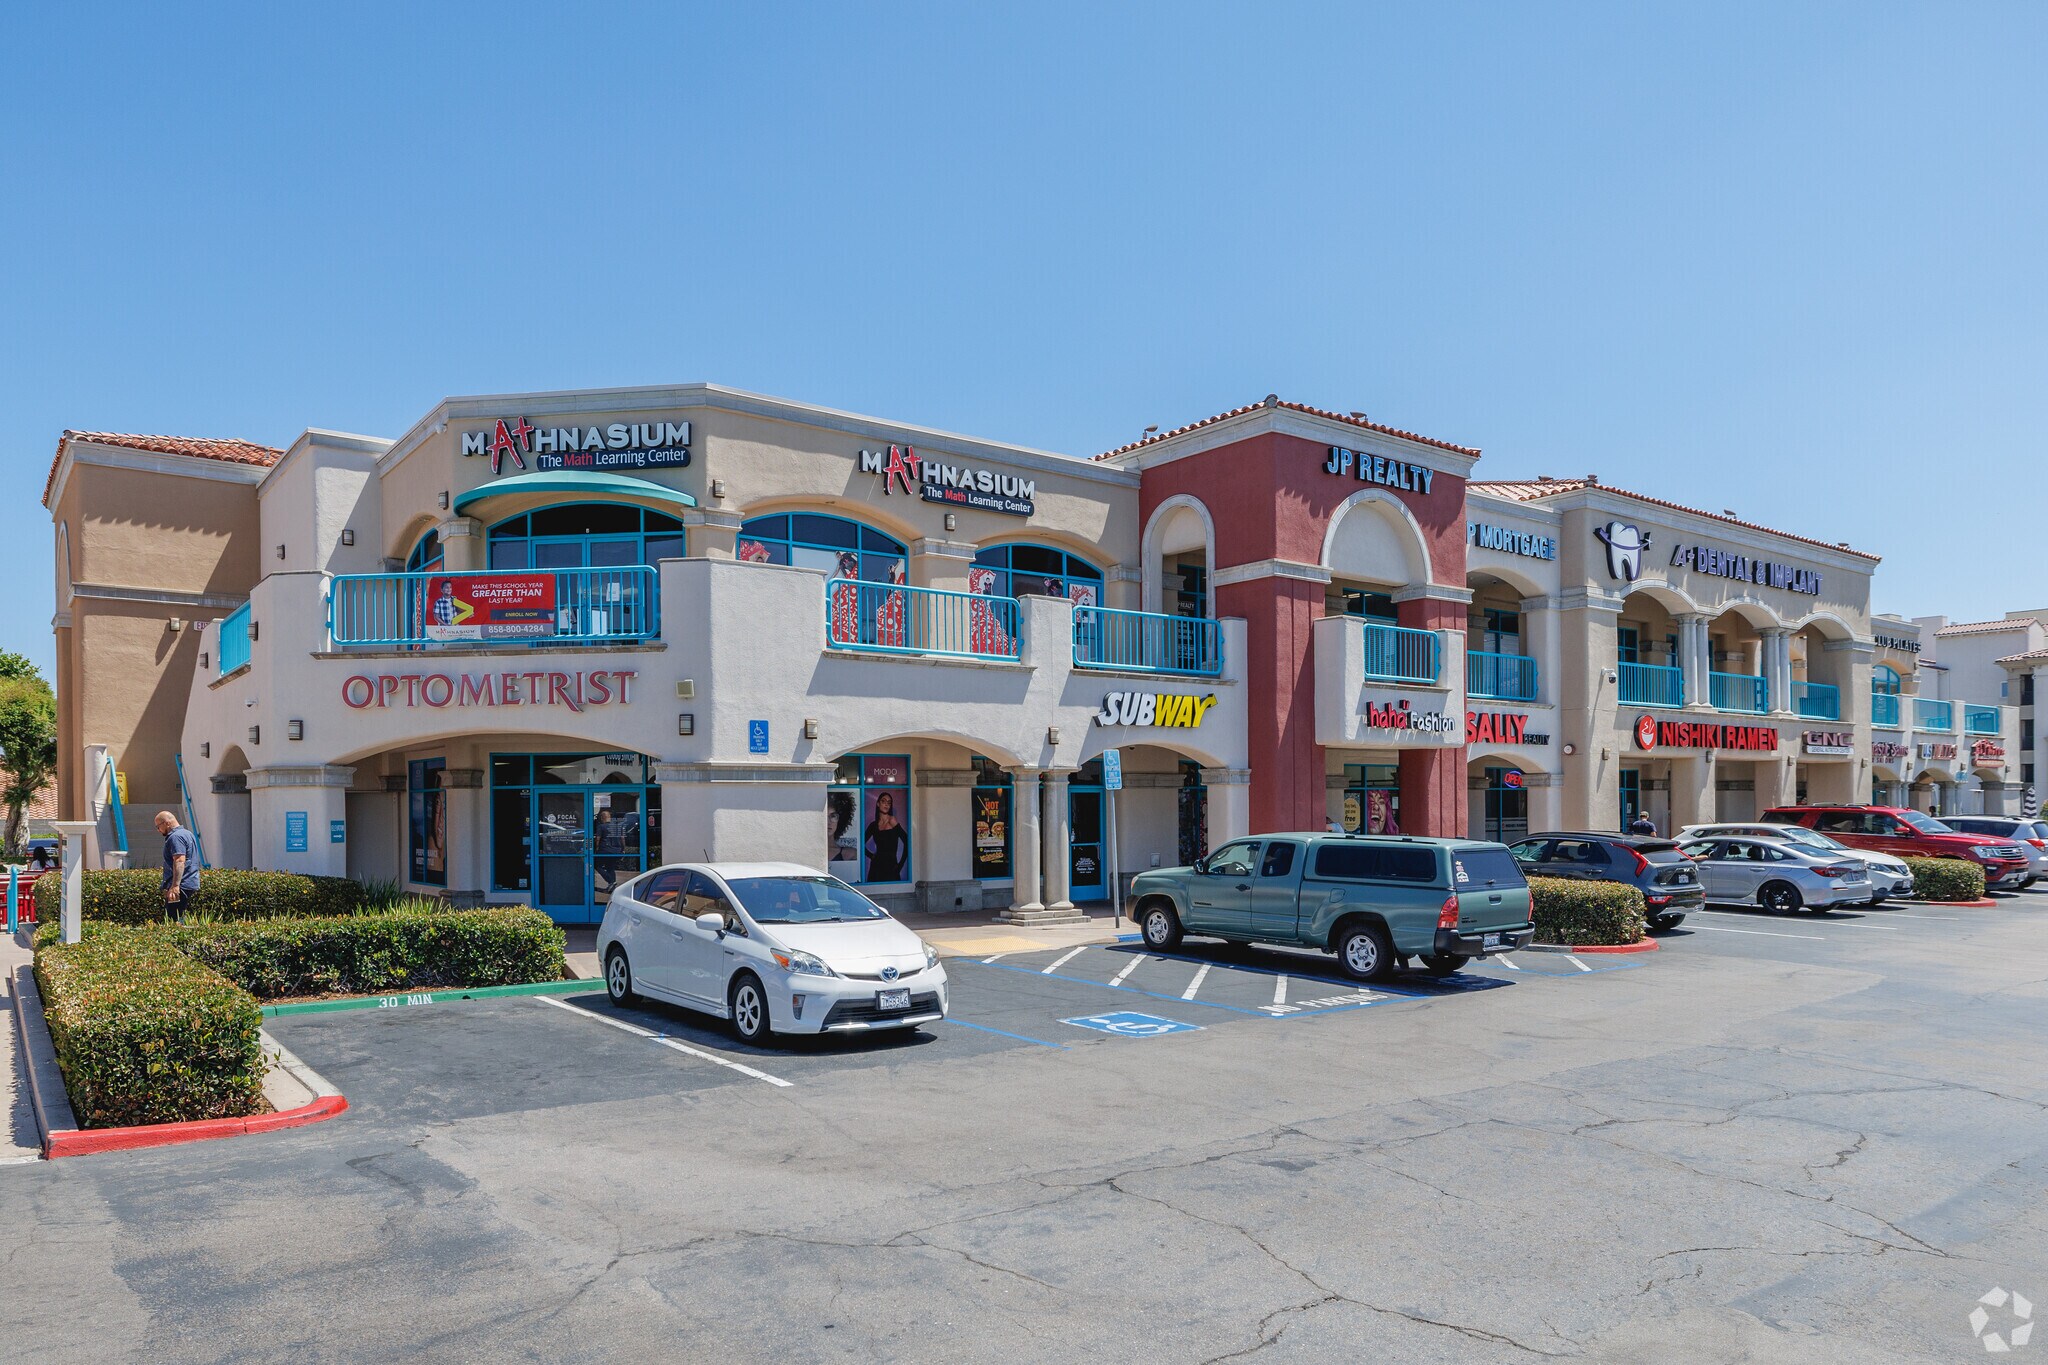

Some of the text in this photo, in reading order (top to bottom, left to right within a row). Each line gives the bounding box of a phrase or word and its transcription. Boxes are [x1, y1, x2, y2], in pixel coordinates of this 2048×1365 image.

[541, 448, 686, 468] The Math Learning Center
[1323, 446, 1434, 494] JP REALTY
[926, 486, 1031, 514] The Math Learning Center
[1476, 523, 1556, 560] MORTGAGE
[1695, 546, 1753, 582] DENTAL
[1754, 559, 1767, 585] &
[1767, 562, 1823, 596] IMPLANT
[472, 588, 542, 598] GREATER THAN
[488, 624, 544, 634] 858-800-4284
[341, 670, 639, 713] OPTOMETRIST
[1094, 691, 1218, 727] SUBWAY
[1408, 710, 1455, 732] Fashion
[1467, 711, 1528, 745] SALLY
[1659, 721, 1778, 751] NISHIKI RAMEN
[1803, 730, 1854, 747] GNC
[873, 768, 898, 776] MODO
[1344, 814, 1356, 822] free
[378, 993, 433, 1009] 30 MIN
